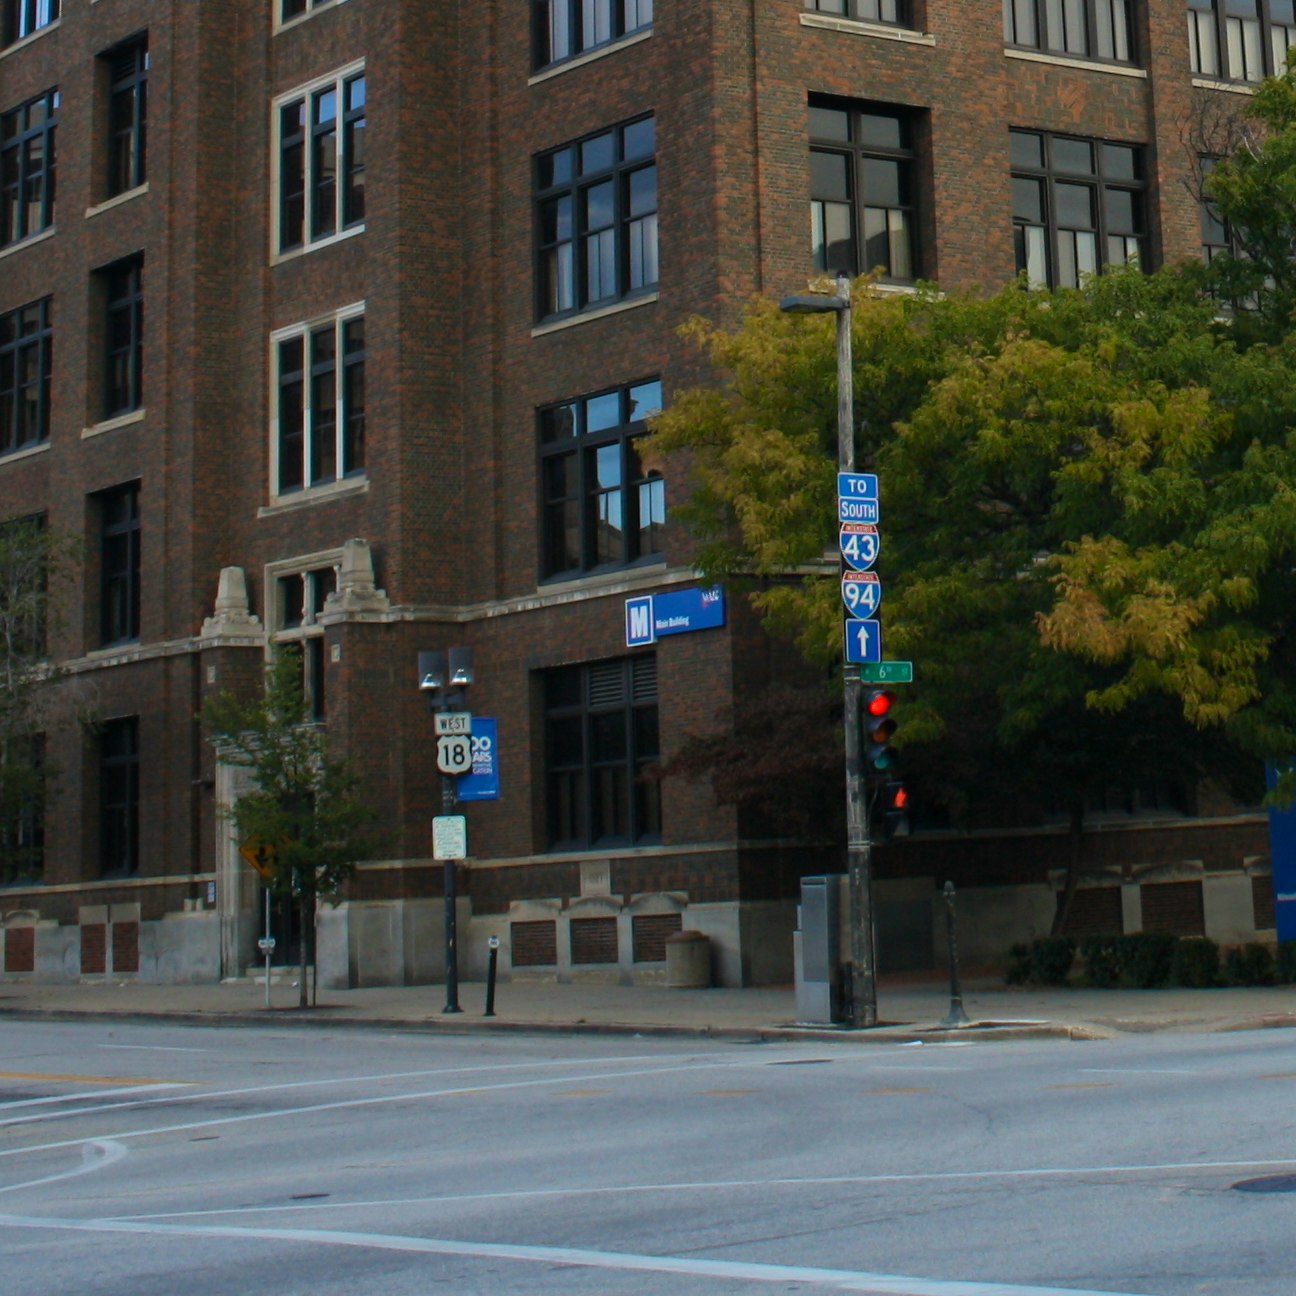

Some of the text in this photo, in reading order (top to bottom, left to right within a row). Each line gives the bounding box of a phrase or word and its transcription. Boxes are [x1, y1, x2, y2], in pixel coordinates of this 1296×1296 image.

[848, 479, 867, 493] TO
[841, 501, 875, 518] SOUTH
[843, 535, 875, 561] 43
[845, 584, 875, 610] 94
[630, 605, 648, 639] M
[441, 717, 466, 730] WEST
[471, 736, 491, 751] 00
[443, 744, 465, 766] 18
